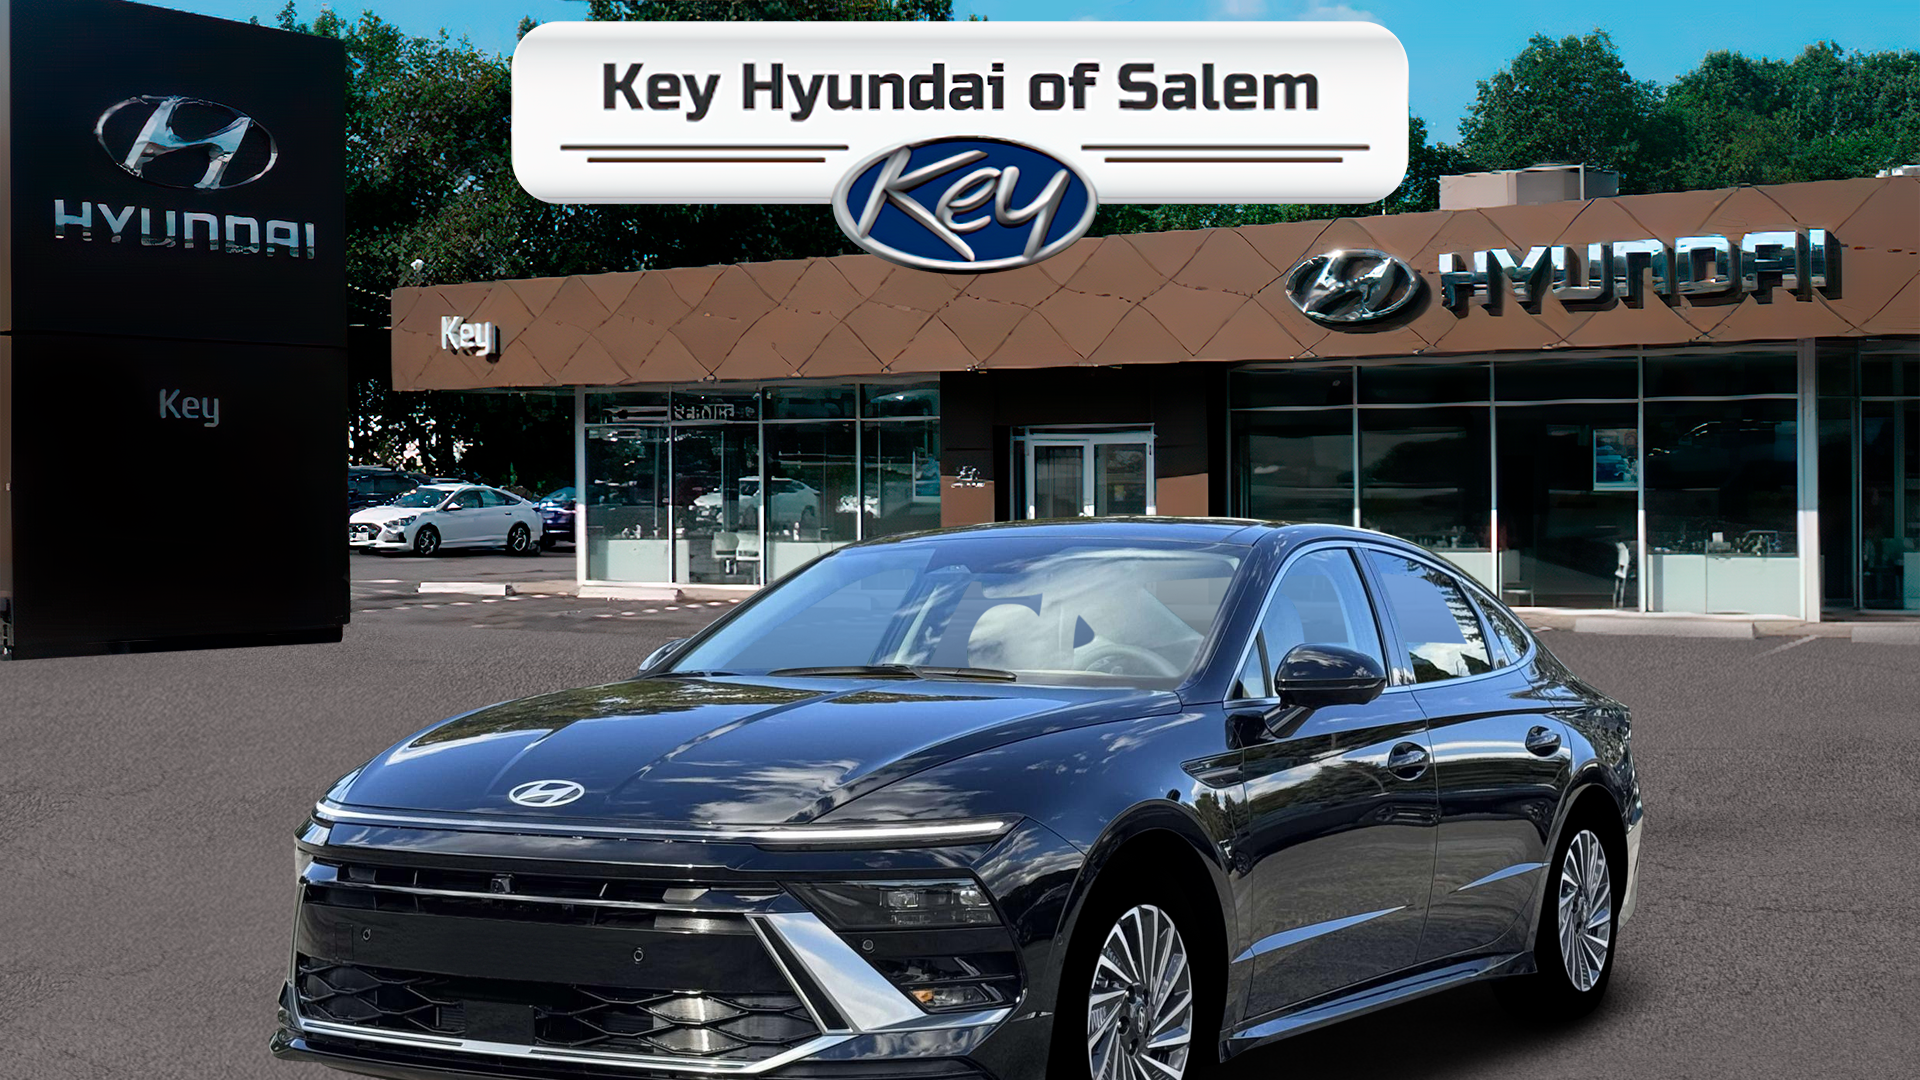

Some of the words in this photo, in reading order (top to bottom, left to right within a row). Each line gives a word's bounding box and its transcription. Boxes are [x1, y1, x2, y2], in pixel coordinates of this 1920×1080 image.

[55, 199, 315, 259] HYUNDAI
[1438, 228, 1832, 313] HYUNDAI
[441, 315, 493, 356] Key
[159, 388, 220, 428] Key
